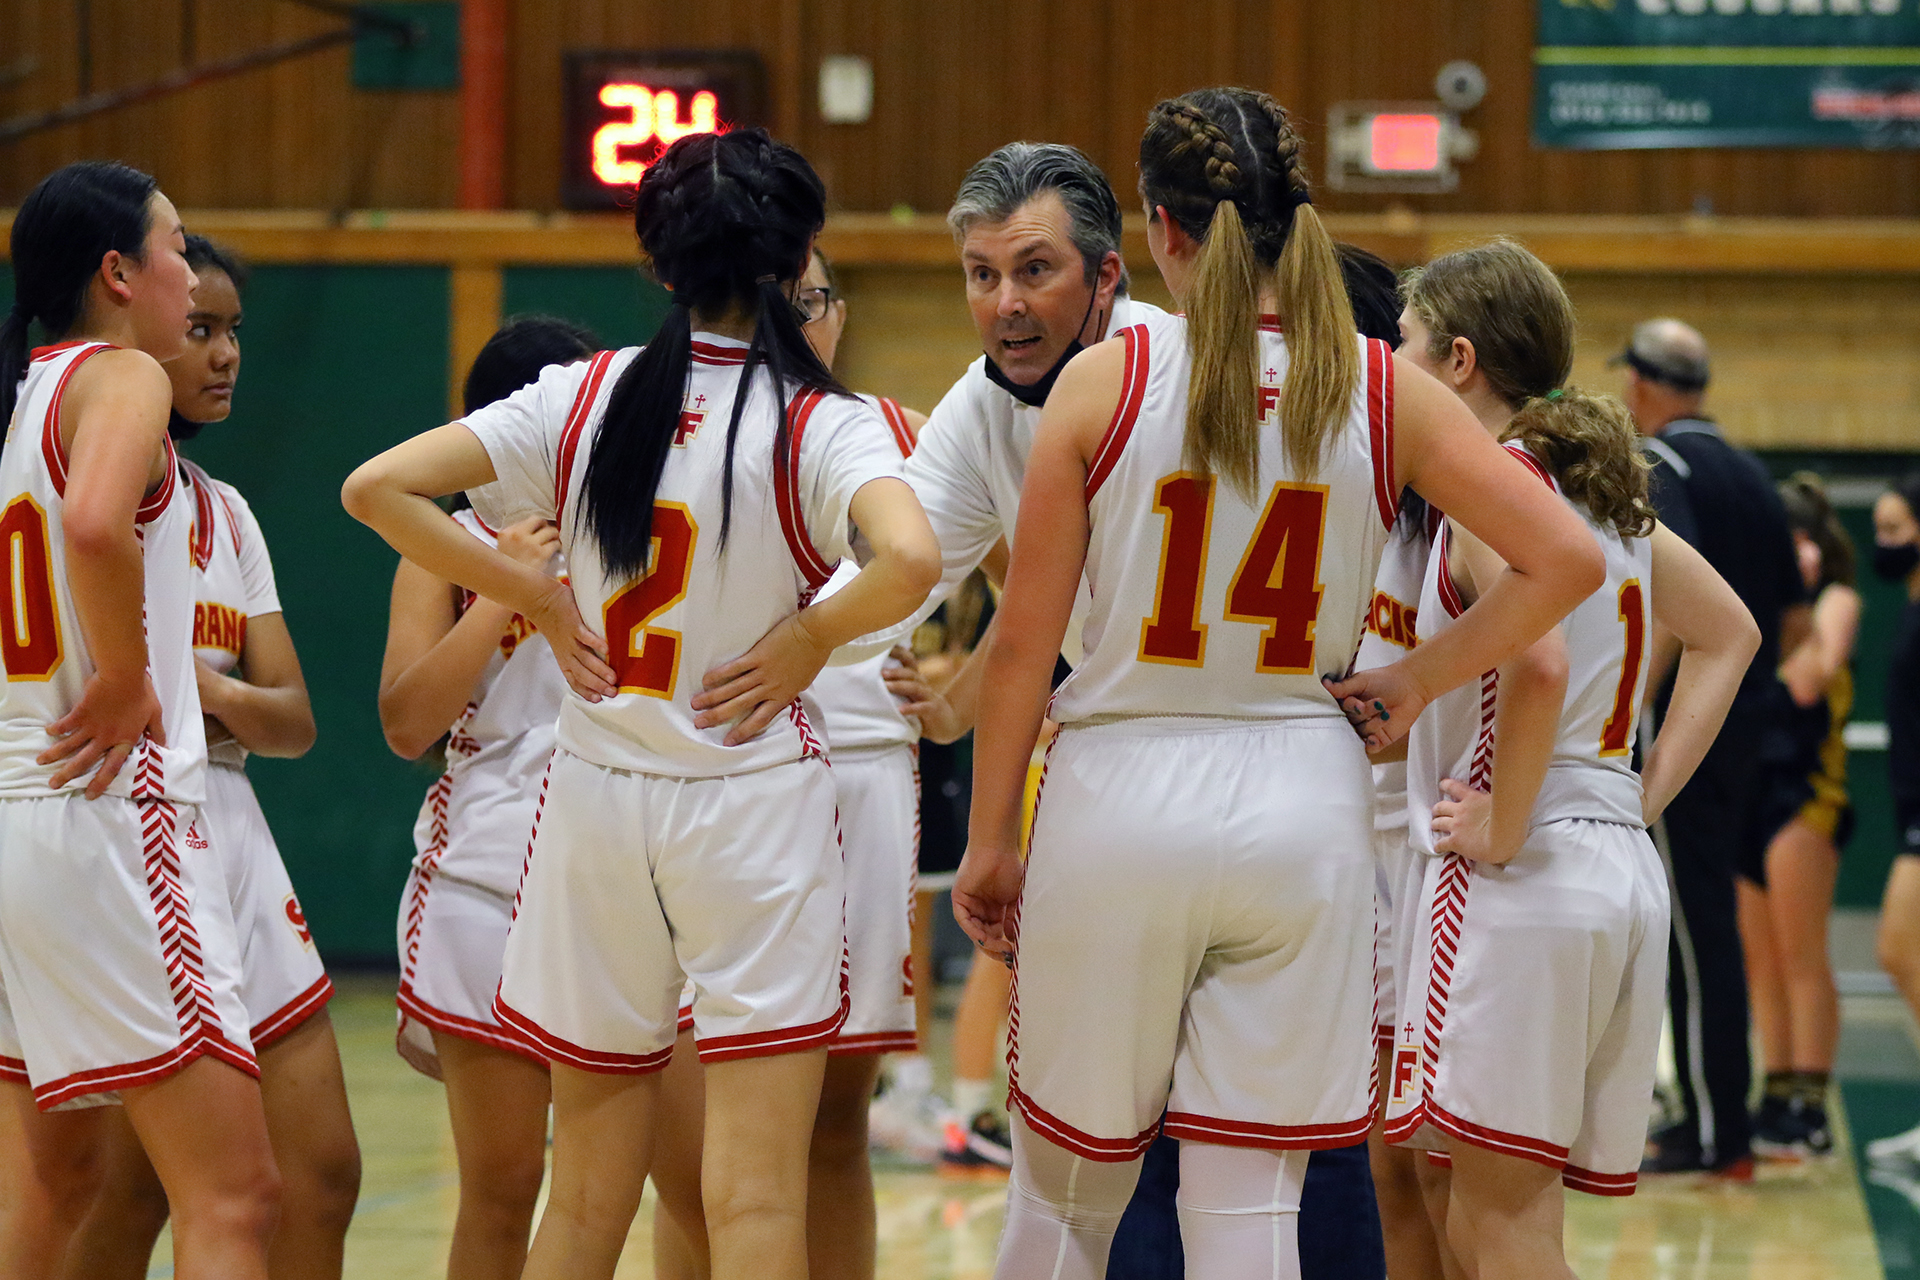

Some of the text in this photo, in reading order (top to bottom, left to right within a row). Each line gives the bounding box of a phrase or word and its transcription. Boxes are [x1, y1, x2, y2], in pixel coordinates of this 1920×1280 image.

[592, 82, 718, 185] 24
[0, 491, 65, 683] 0
[602, 500, 699, 701] 2
[1137, 470, 1330, 676] 14
[1599, 577, 1646, 758] 1
[1392, 1045, 1421, 1104] F
